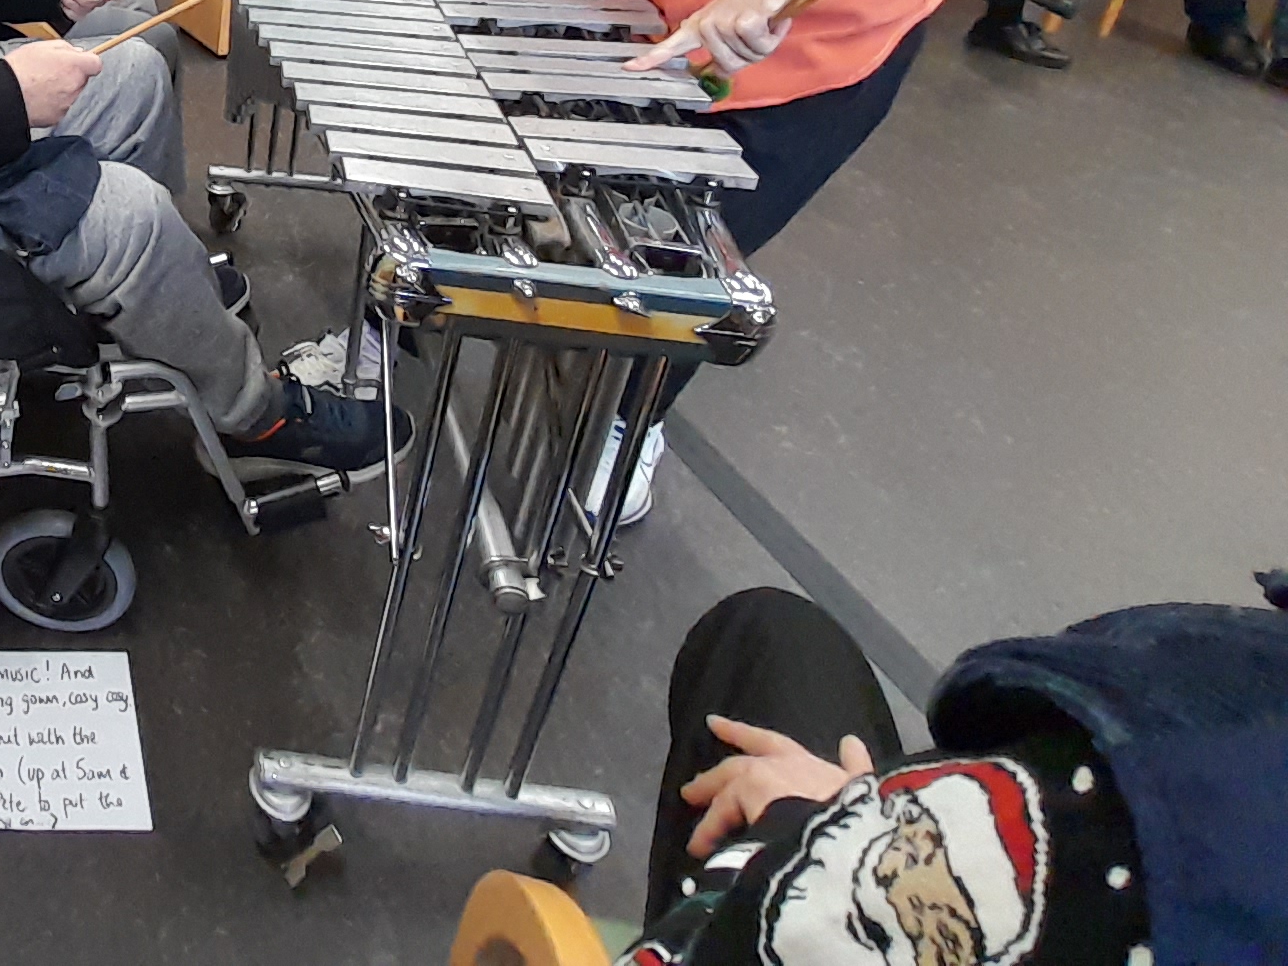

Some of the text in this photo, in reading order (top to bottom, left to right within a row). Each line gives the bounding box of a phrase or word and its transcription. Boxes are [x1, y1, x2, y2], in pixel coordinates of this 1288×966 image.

[61, 662, 94, 680] And
[28, 726, 65, 746] with
[73, 726, 97, 746] the
[51, 761, 67, 779] at
[38, 791, 51, 813] to
[63, 793, 85, 819] put
[98, 791, 123, 811] the
